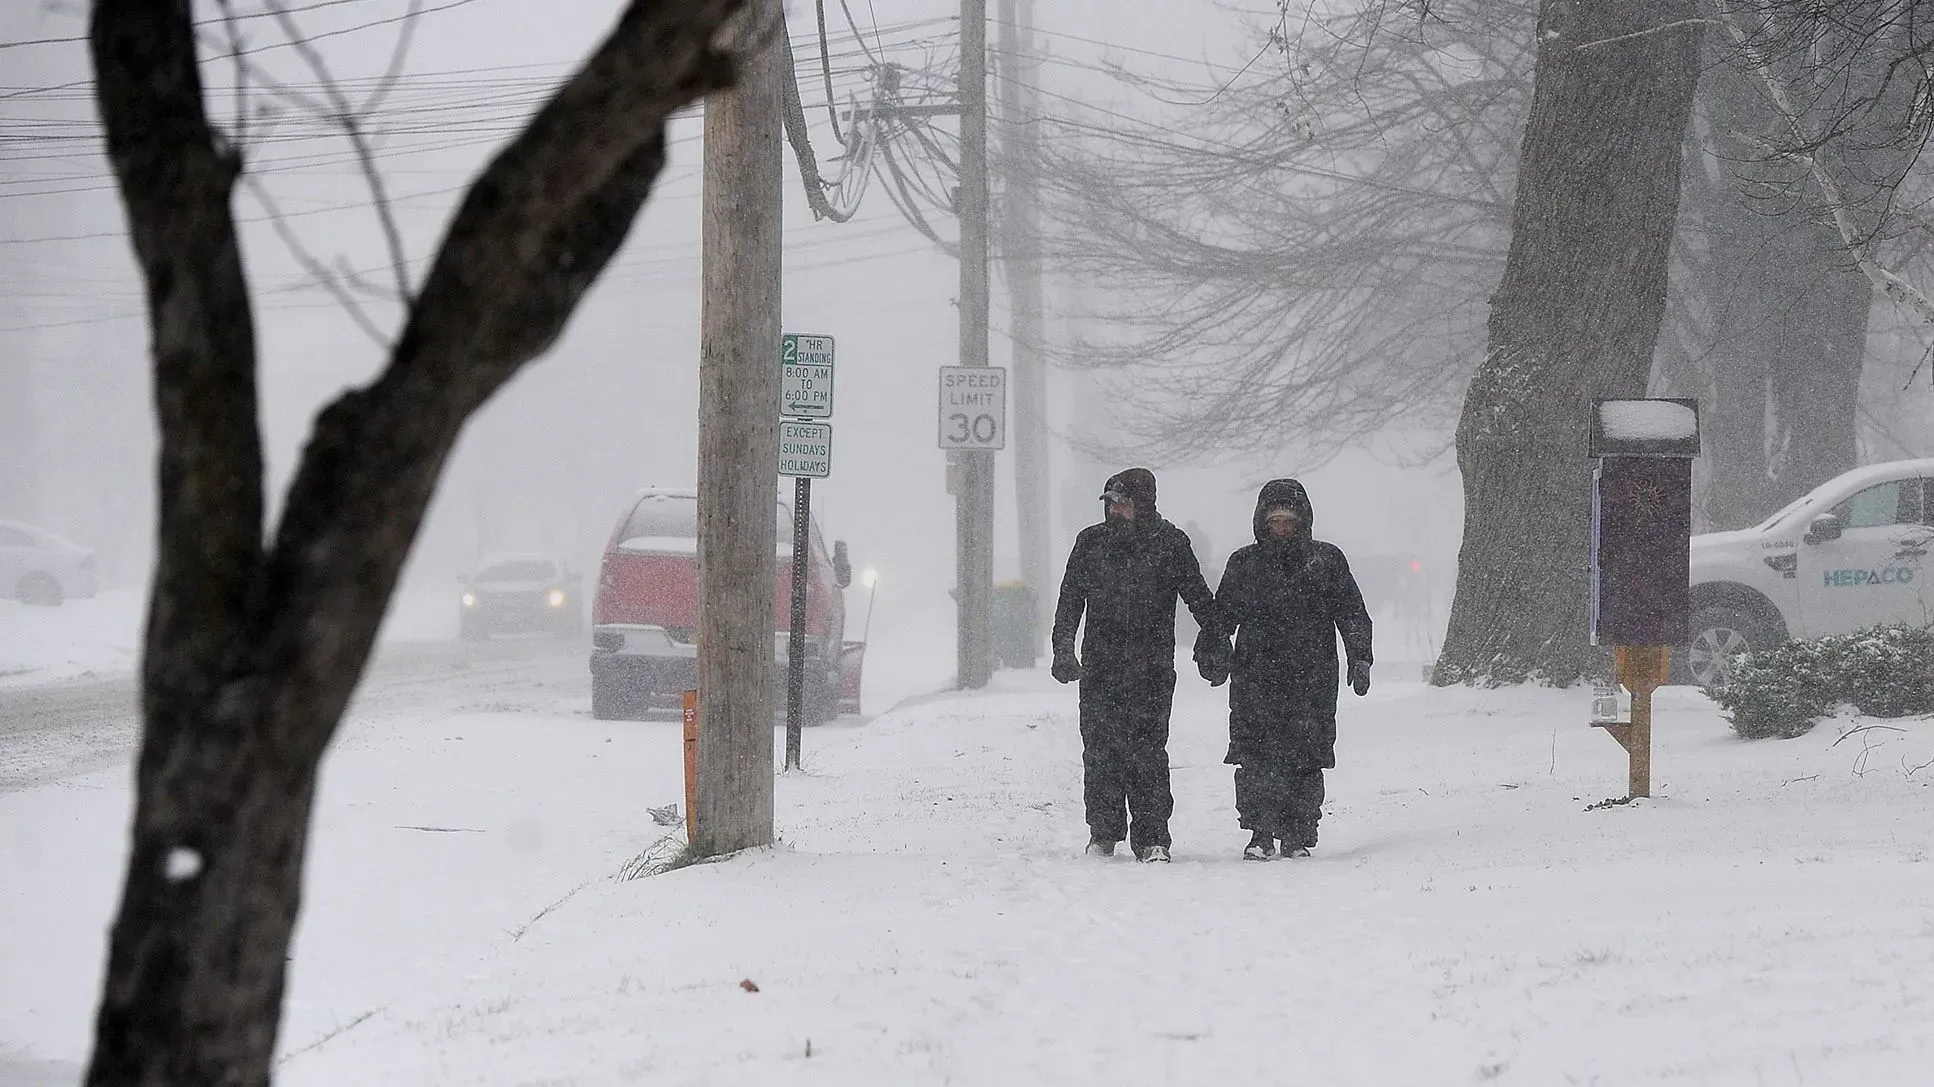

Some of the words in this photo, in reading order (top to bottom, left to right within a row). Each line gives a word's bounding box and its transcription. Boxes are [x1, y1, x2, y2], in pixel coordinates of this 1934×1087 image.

[783, 340, 796, 362] 2
[797, 352, 831, 363] STANDING
[786, 367, 809, 378] 8:00
[815, 368, 828, 379] AM
[801, 379, 813, 390] TO
[945, 374, 1001, 388] SPEED
[785, 390, 808, 401] 6:00
[813, 391, 828, 402] PM
[950, 392, 994, 406] LIMIT
[786, 427, 824, 439] EXCEPT
[947, 413, 996, 444] 30
[782, 443, 826, 456] SUNDAYS
[780, 459, 827, 472] HOLIDAYS
[1823, 566, 1914, 587] HEPACO
